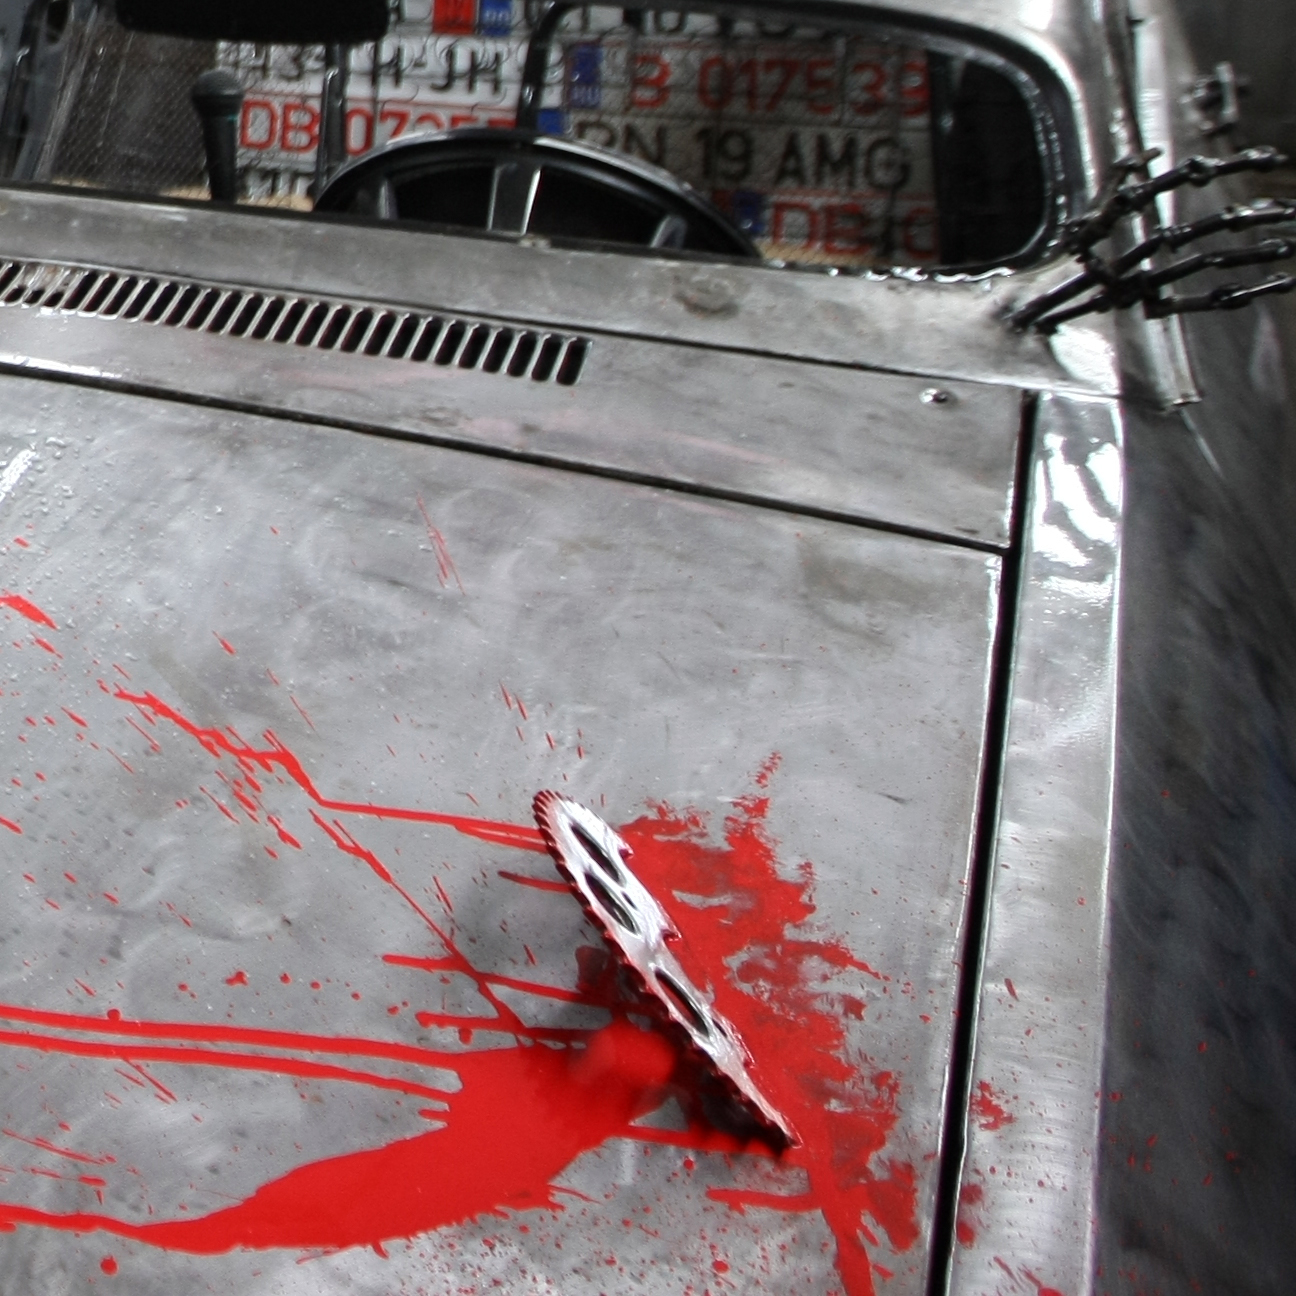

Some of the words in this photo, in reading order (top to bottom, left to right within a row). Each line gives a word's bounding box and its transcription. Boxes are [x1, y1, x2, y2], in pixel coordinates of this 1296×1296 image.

[239, 98, 320, 153] DB
[695, 125, 755, 183] 19
[773, 131, 911, 190] AMG
